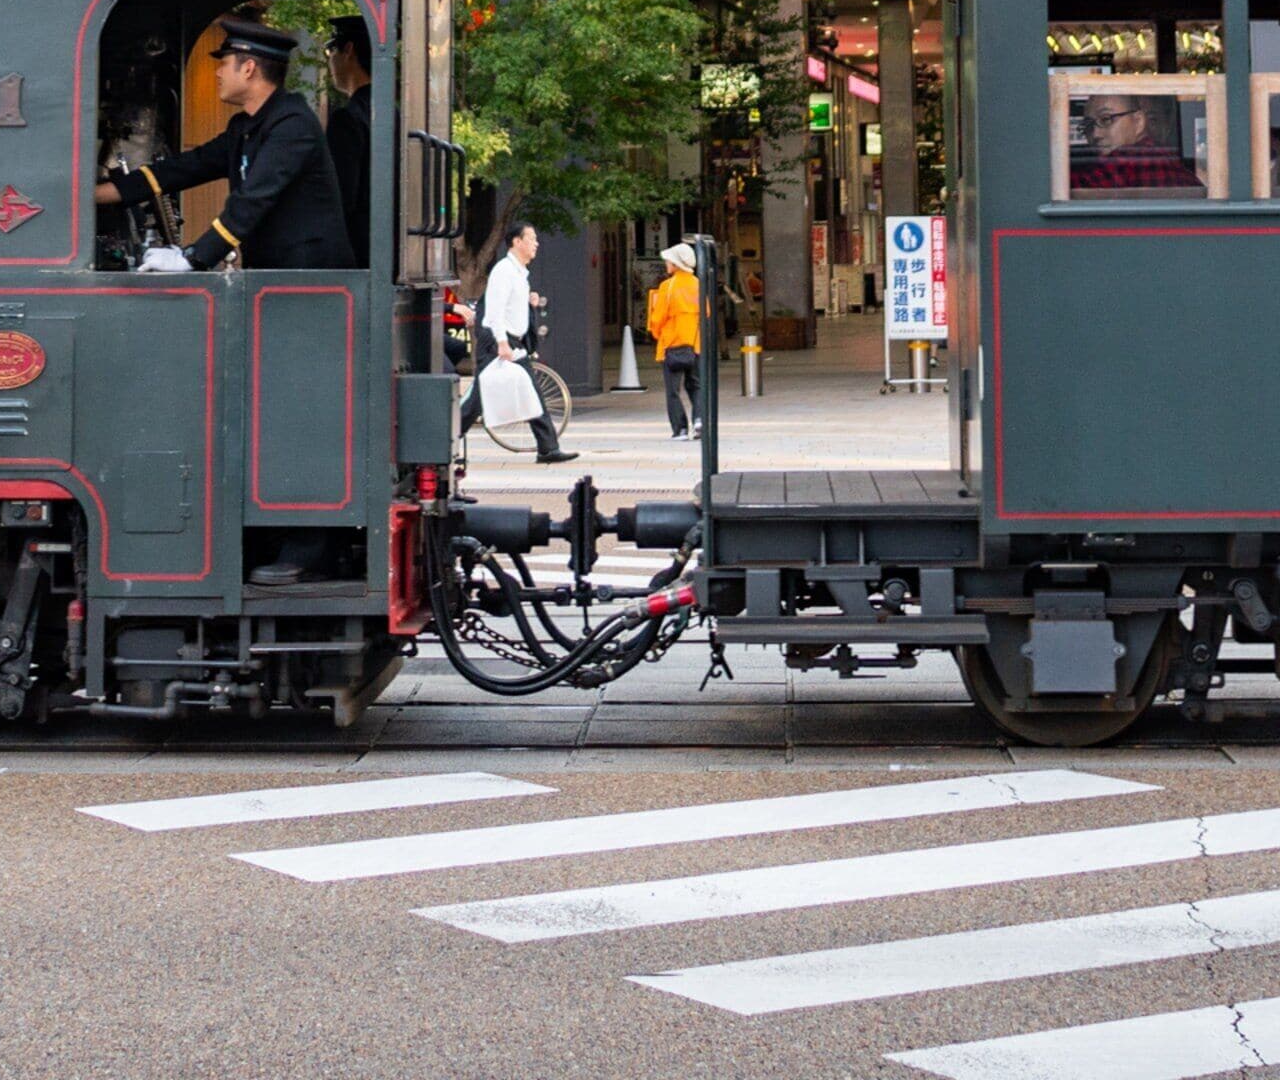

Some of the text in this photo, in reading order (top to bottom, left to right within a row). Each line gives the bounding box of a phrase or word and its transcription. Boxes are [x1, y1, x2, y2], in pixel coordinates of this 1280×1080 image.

[893, 258, 909, 322] 専用道路
[911, 258, 926, 322] 歩行者
